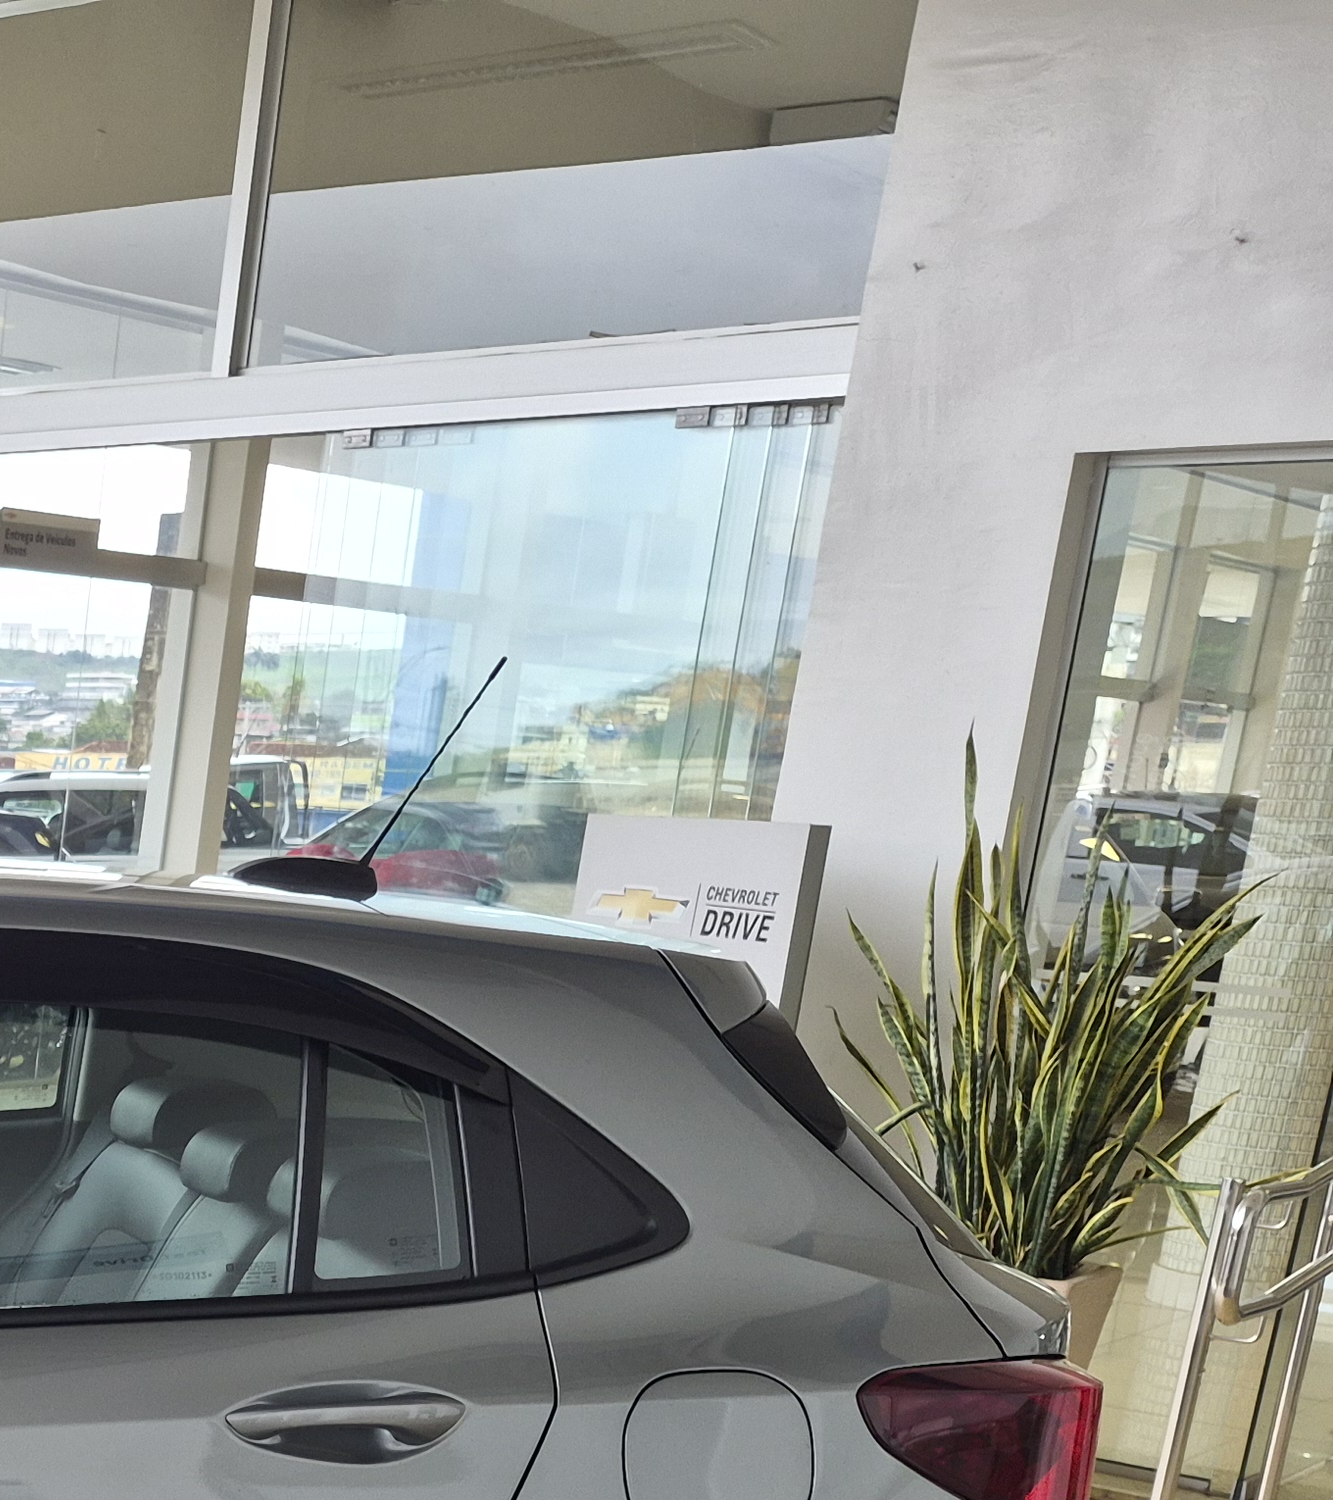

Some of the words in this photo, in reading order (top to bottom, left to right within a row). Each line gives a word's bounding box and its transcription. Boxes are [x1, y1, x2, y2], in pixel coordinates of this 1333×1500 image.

[5, 528, 33, 545] Entrega
[35, 531, 44, 543] de
[706, 885, 779, 907] CHEVROLET
[700, 909, 775, 943] DRIVE
